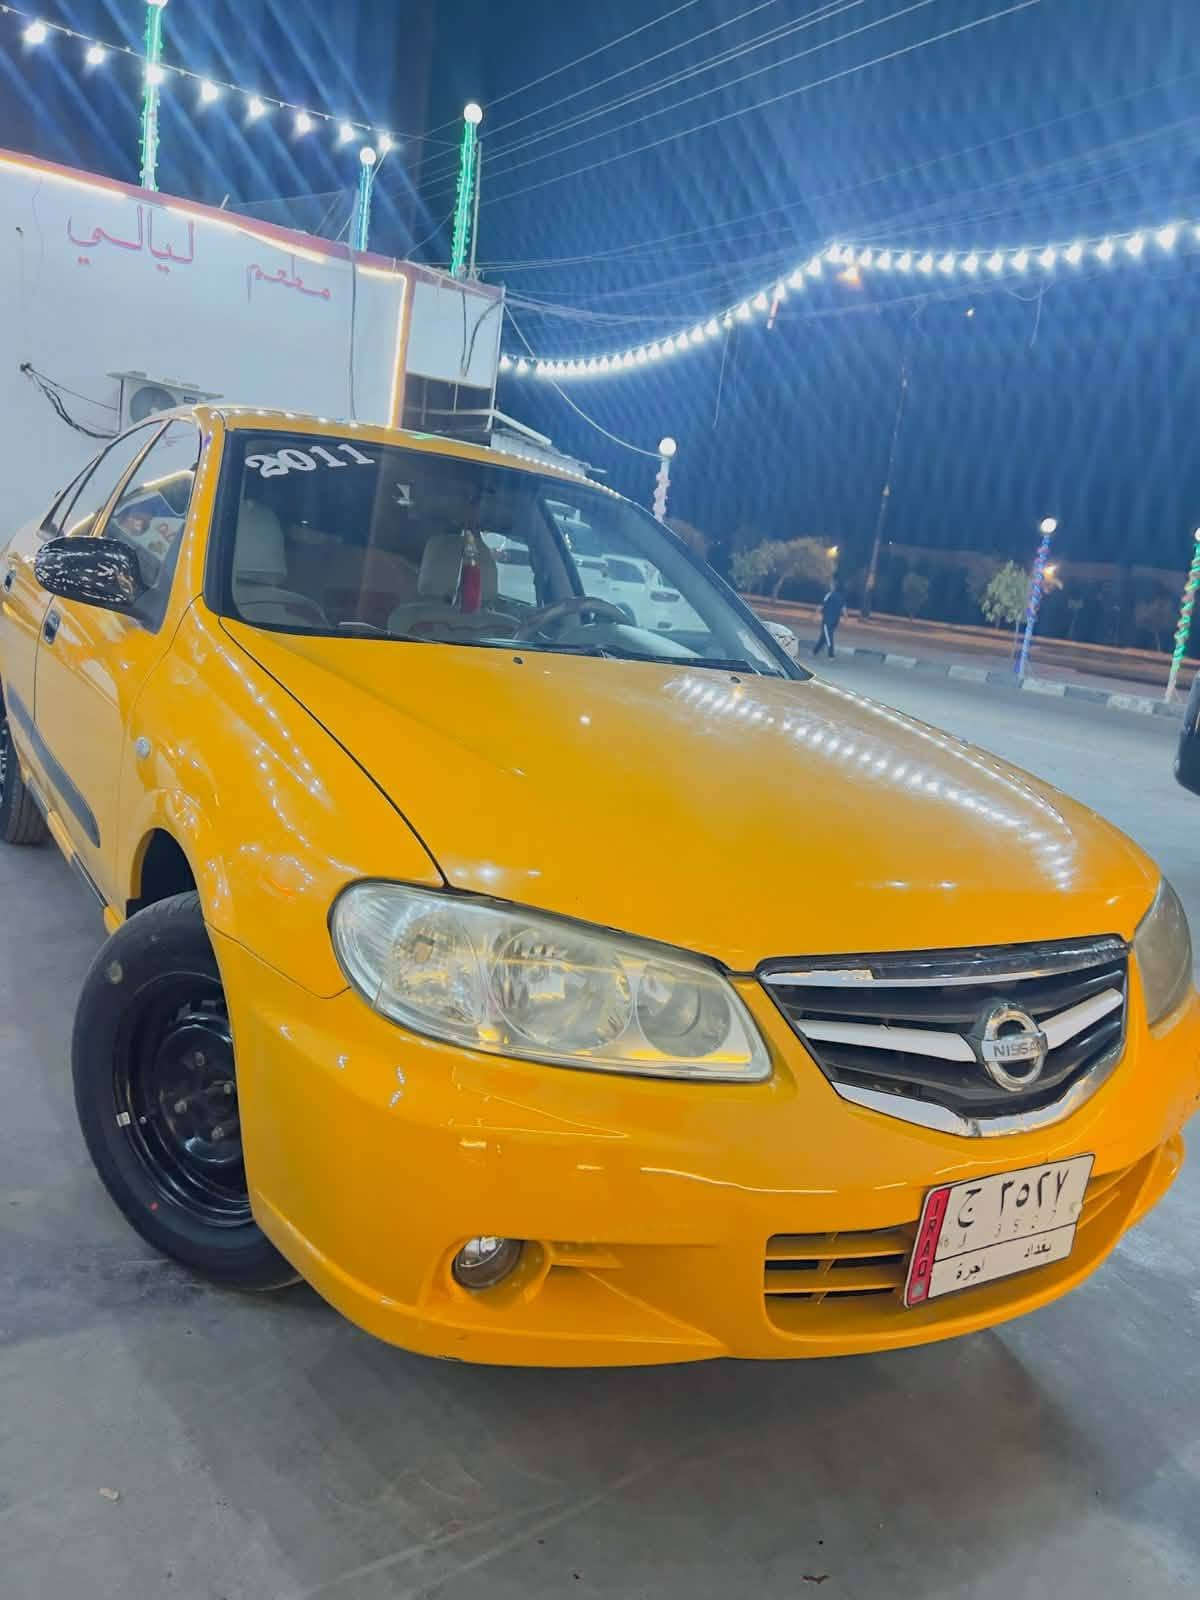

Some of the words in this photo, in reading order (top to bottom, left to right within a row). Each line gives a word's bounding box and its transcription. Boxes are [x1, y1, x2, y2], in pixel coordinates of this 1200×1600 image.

[66, 205, 194, 273] ليالي
[247, 255, 331, 304] مطعم
[245, 443, 376, 479] 2011
[918, 1198, 940, 1278] IRAQ
